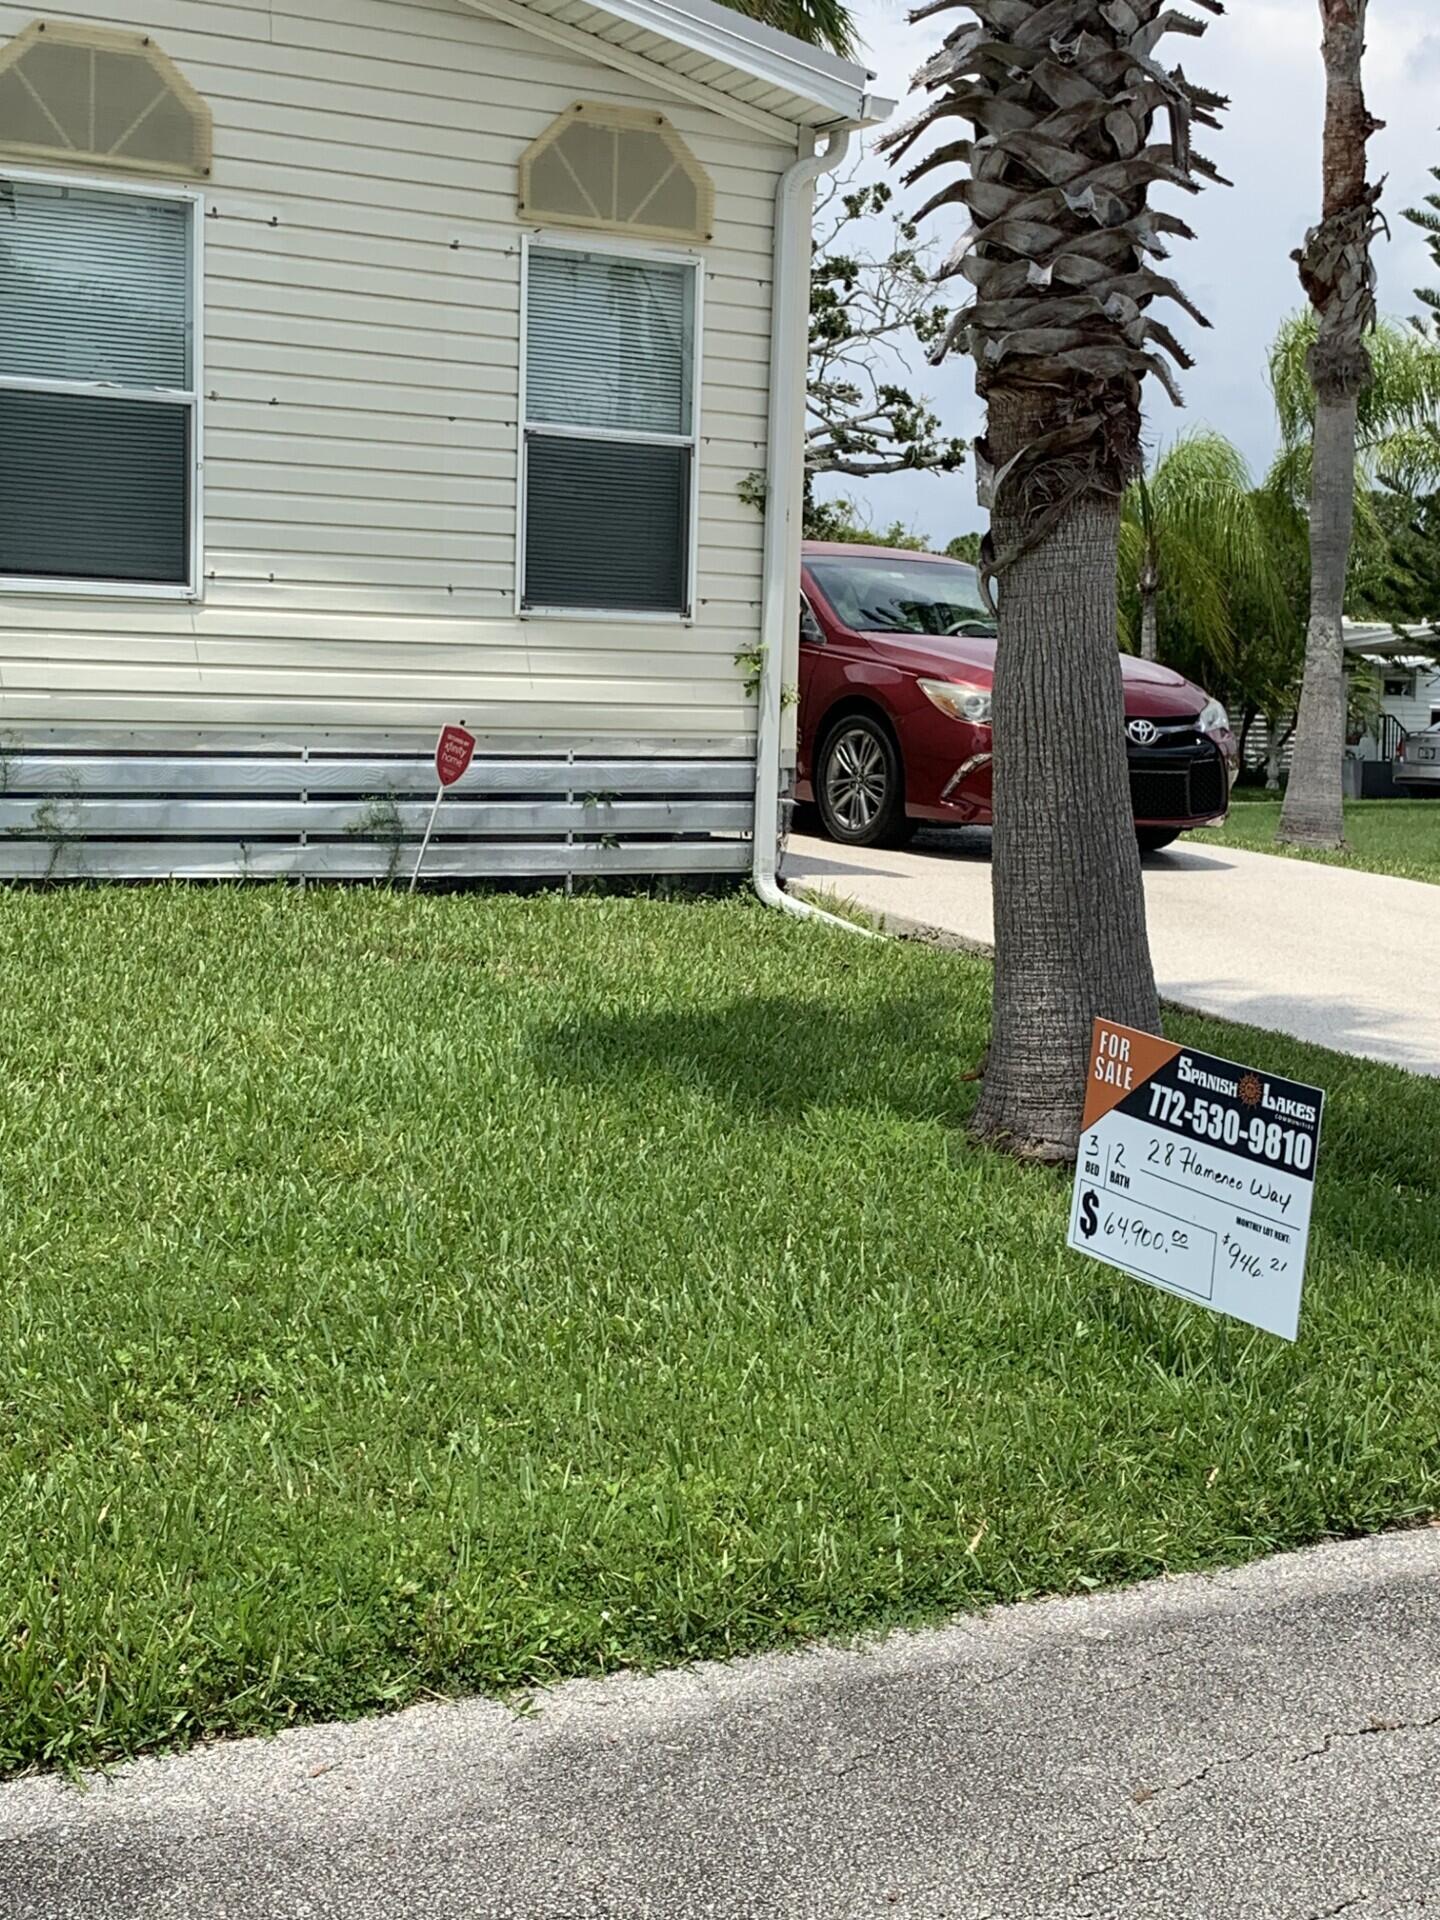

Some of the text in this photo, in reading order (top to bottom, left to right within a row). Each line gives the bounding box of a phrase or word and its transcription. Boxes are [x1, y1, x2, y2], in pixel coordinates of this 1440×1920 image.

[441, 752, 463, 768] home
[1099, 1030, 1131, 1061] FOR
[1094, 1056, 1134, 1091] SALE
[1177, 1055, 1316, 1122] SPANISH LAKES
[1148, 1082, 1313, 1171] 772-530-9810
[1084, 1134, 1100, 1156] 3
[1113, 1143, 1126, 1169] 2
[1085, 1161, 1100, 1178] BED
[1109, 1171, 1131, 1190] BATH
[1147, 1139, 1175, 1167] 28
[1249, 1178, 1292, 1214] Way
[1235, 1215, 1262, 1233] MONTHLY
[1262, 1226, 1274, 1238] LOT
